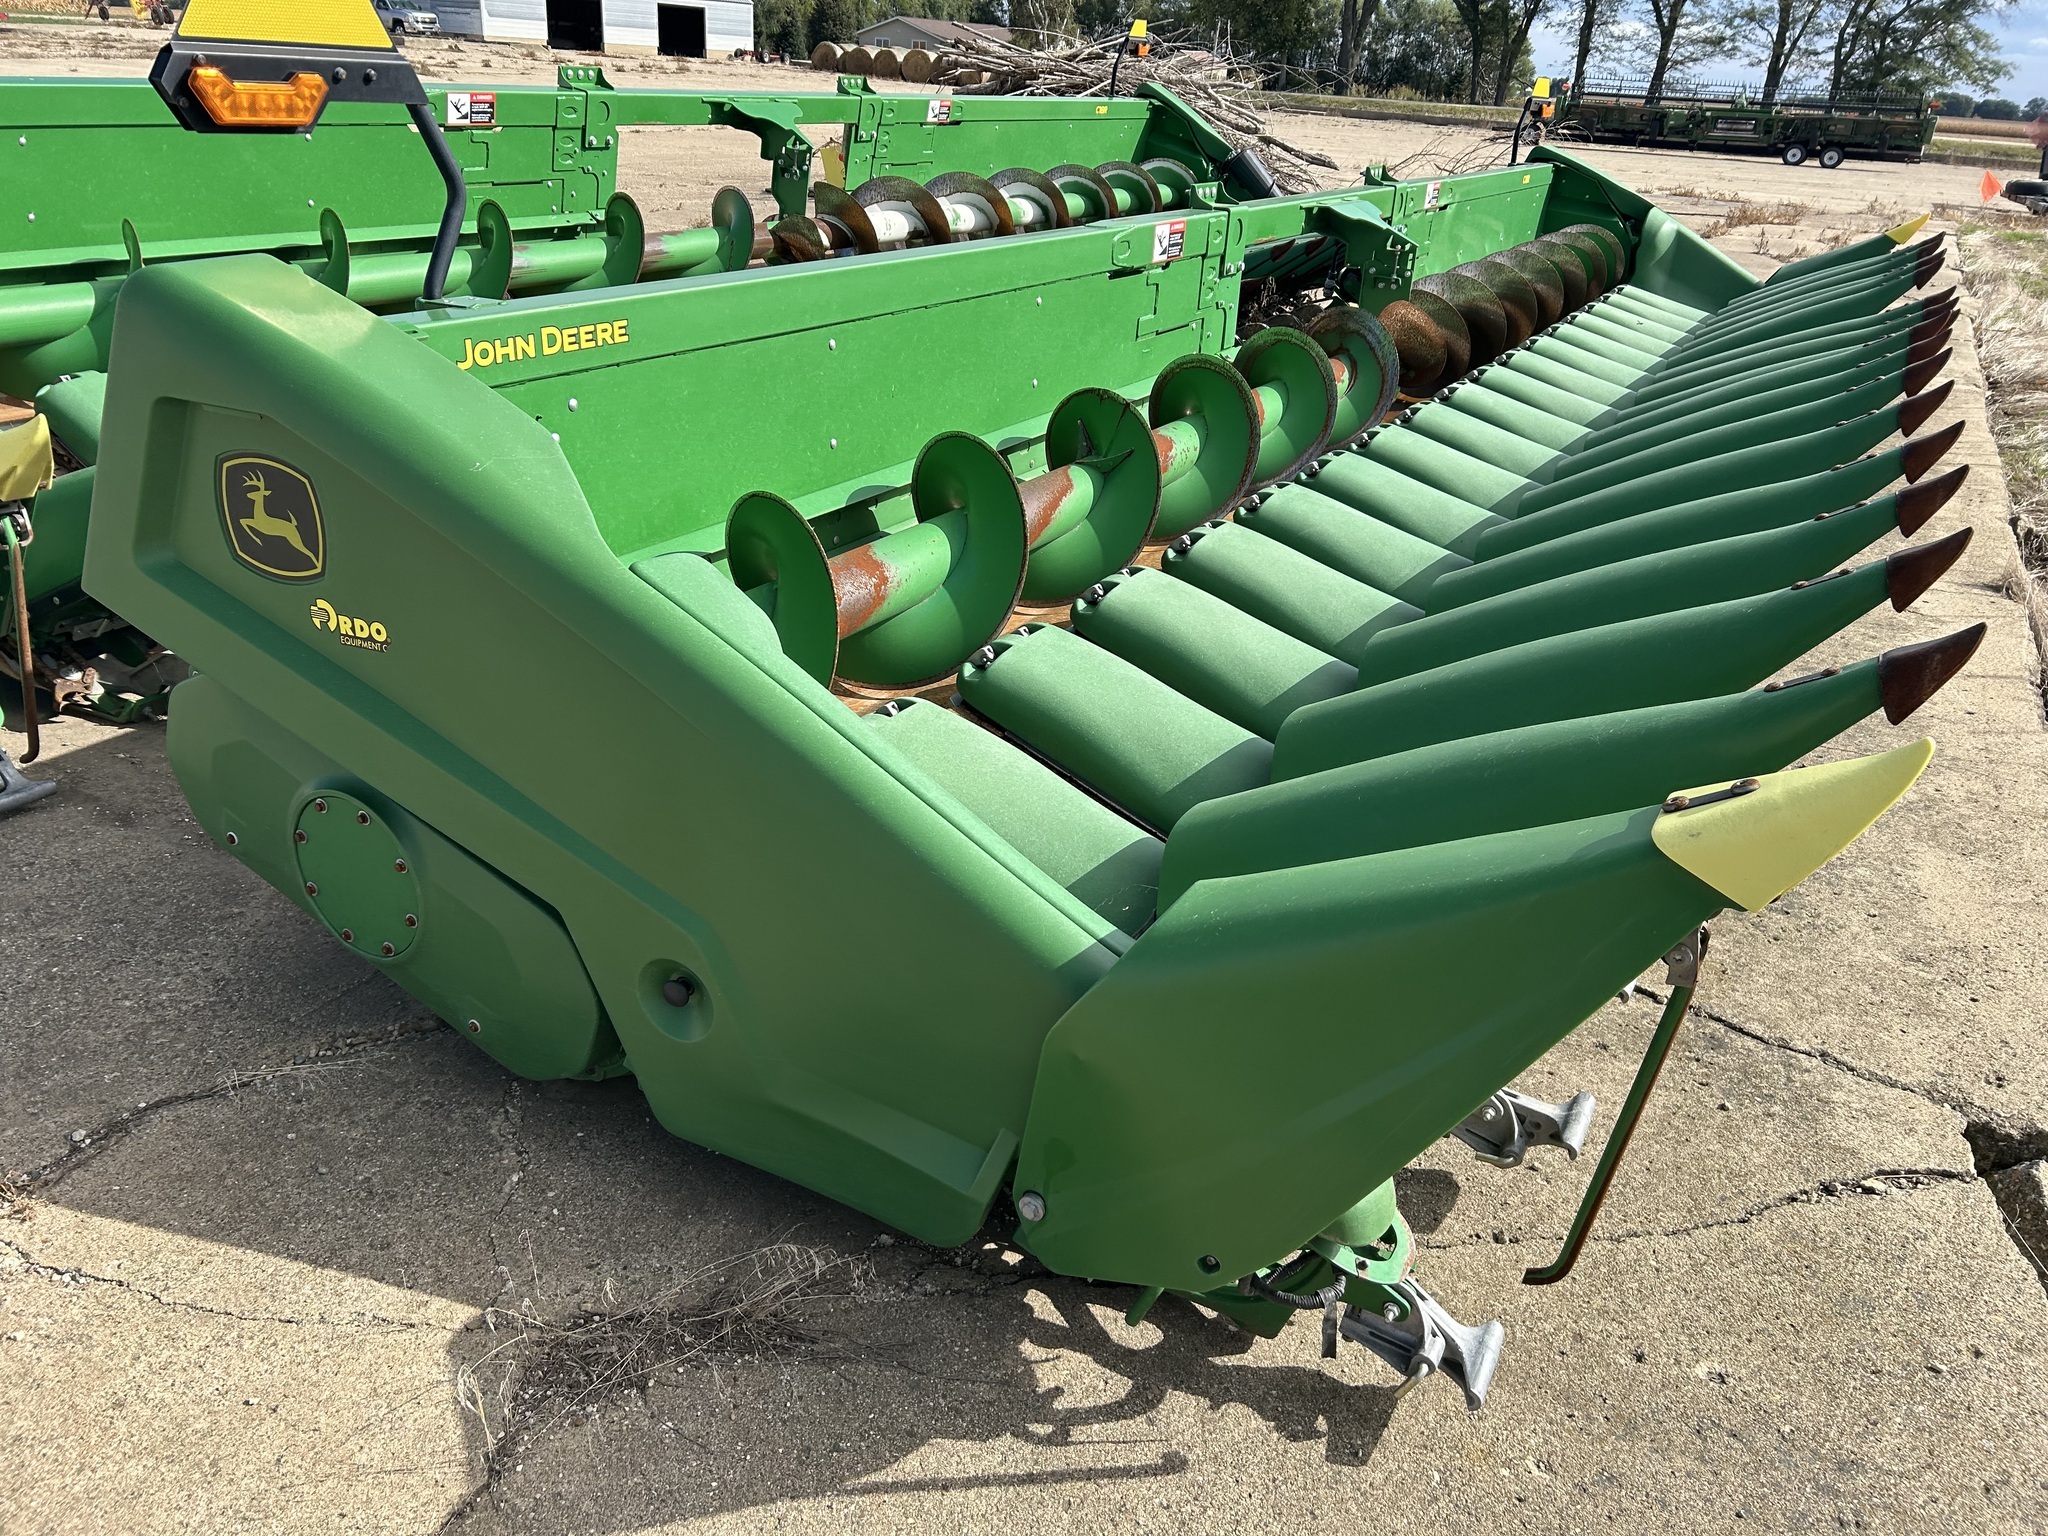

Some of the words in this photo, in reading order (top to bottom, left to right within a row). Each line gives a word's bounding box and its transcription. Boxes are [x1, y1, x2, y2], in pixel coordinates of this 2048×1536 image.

[456, 332, 536, 371] JOHN
[540, 318, 630, 357] DEERE
[340, 634, 381, 652] EQUIPMENT
